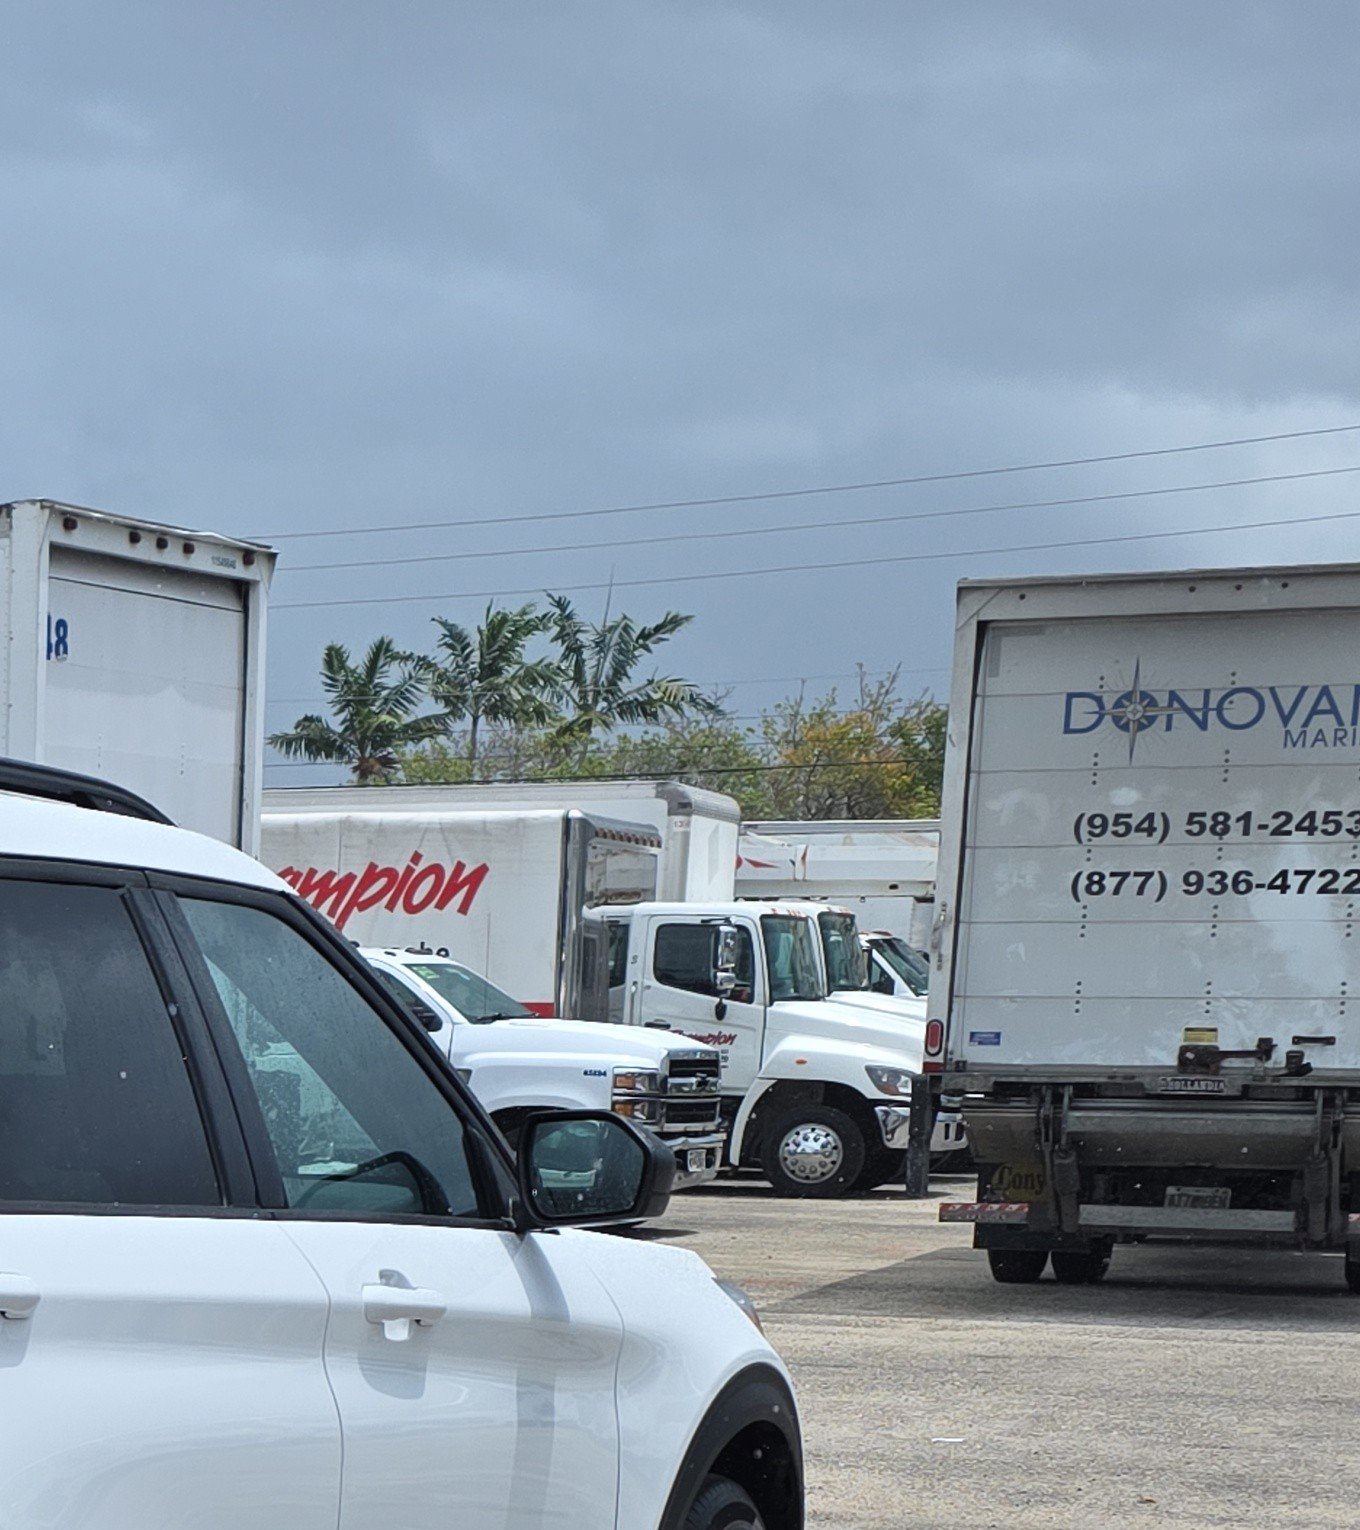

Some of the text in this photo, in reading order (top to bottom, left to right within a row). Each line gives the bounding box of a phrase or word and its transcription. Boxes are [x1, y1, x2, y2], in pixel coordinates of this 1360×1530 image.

[1062, 684, 1360, 735] DONOVA
[1073, 811, 1360, 845] (954) 581-2453
[1070, 869, 1360, 903] (877) 936-4722
